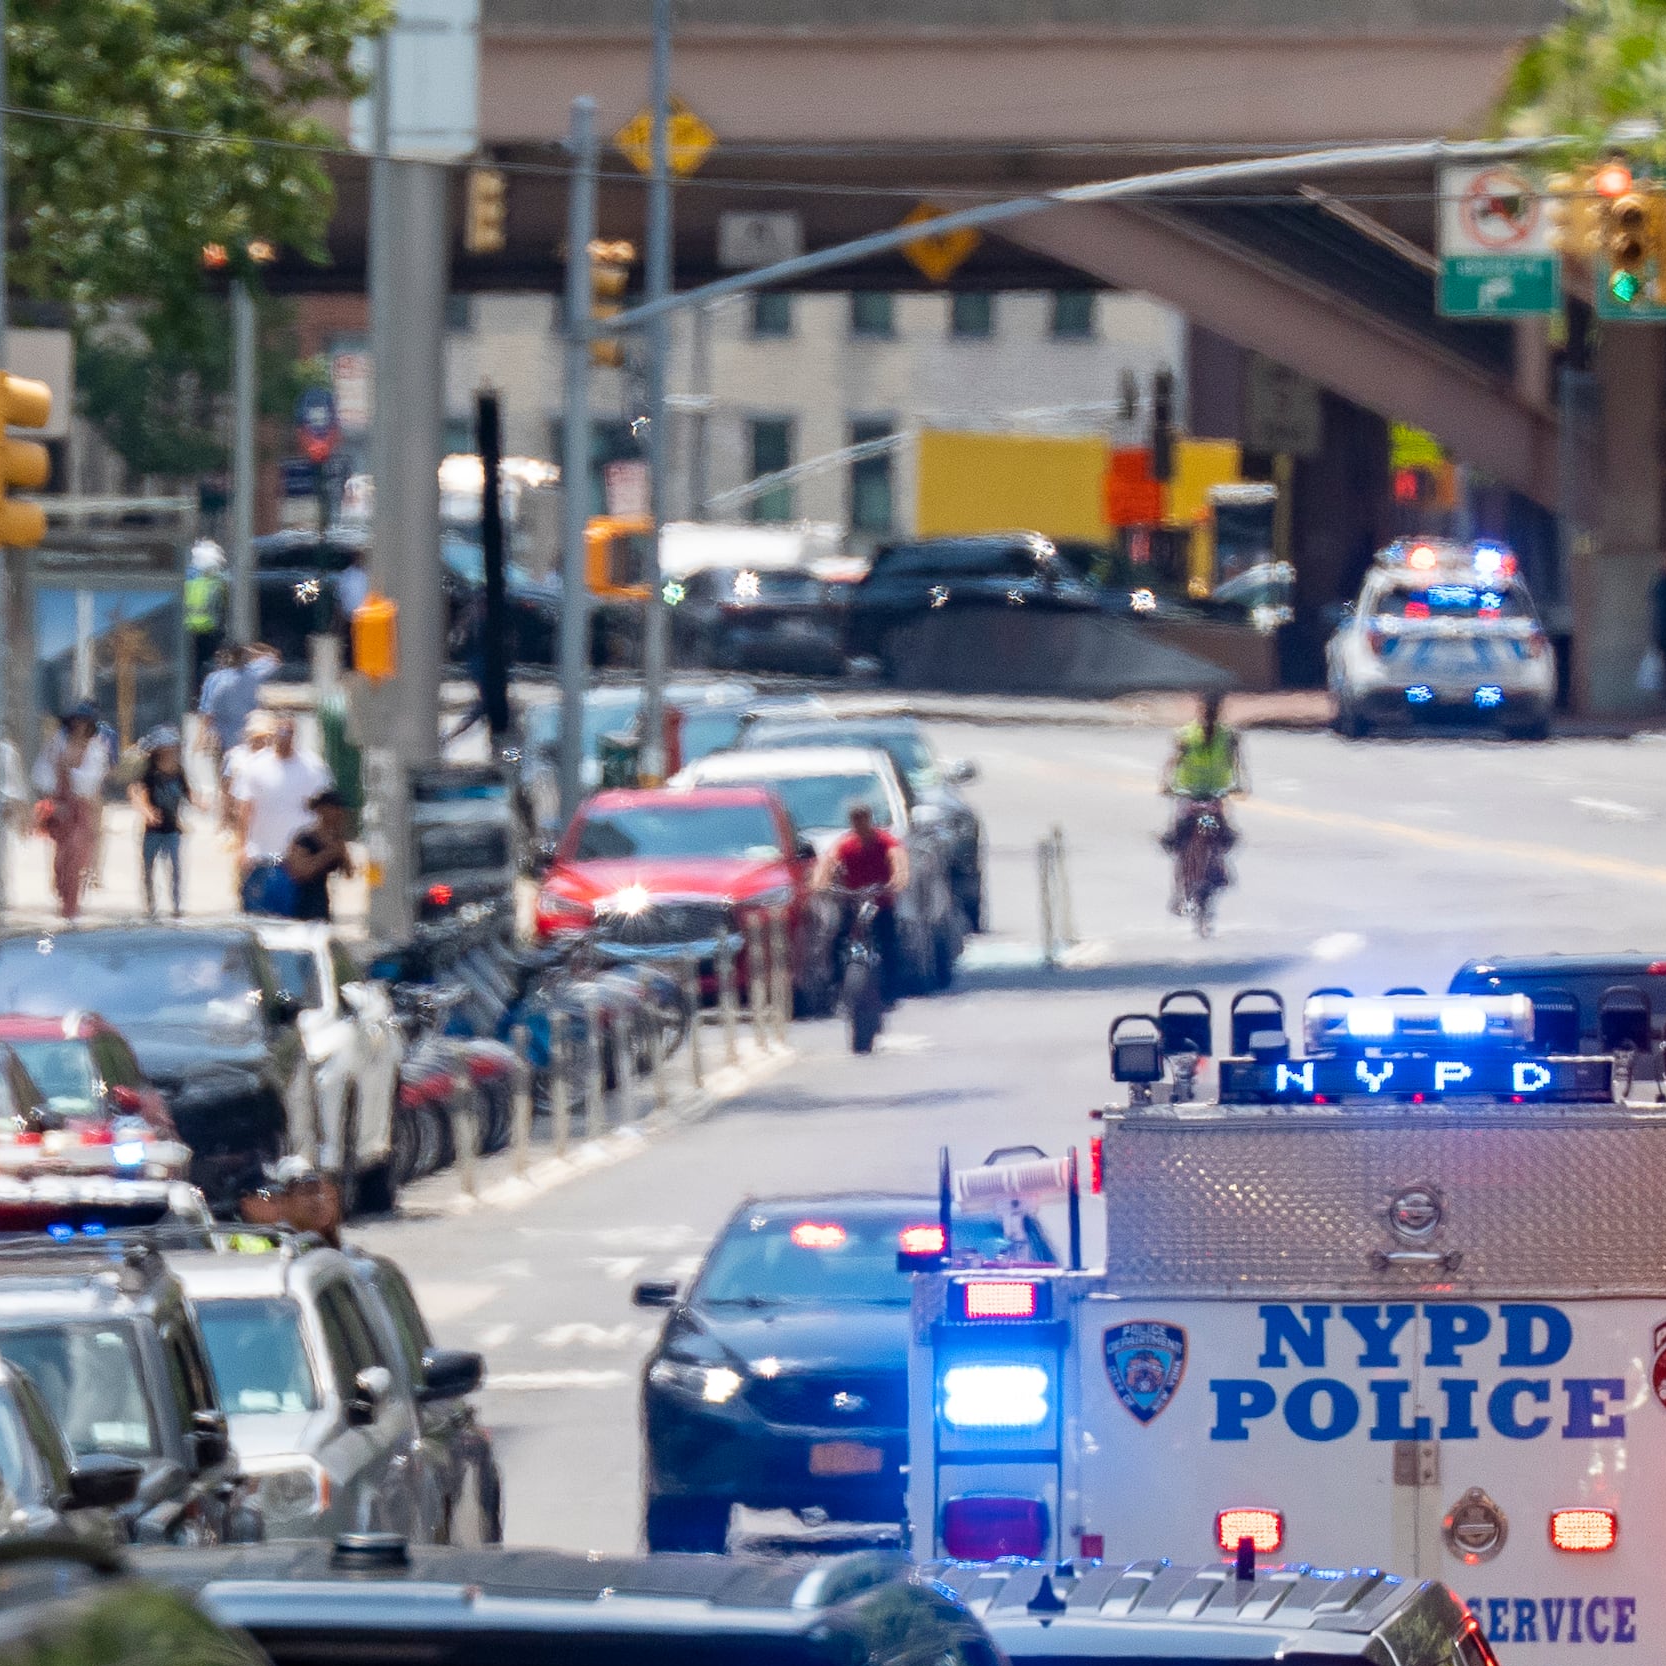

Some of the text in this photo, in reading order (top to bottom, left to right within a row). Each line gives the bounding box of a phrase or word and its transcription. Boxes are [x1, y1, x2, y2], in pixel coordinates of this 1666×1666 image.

[1122, 1324, 1166, 1341] POLICE
[1258, 1304, 1573, 1368] NYPD
[1209, 1378, 1626, 1441] POLICE
